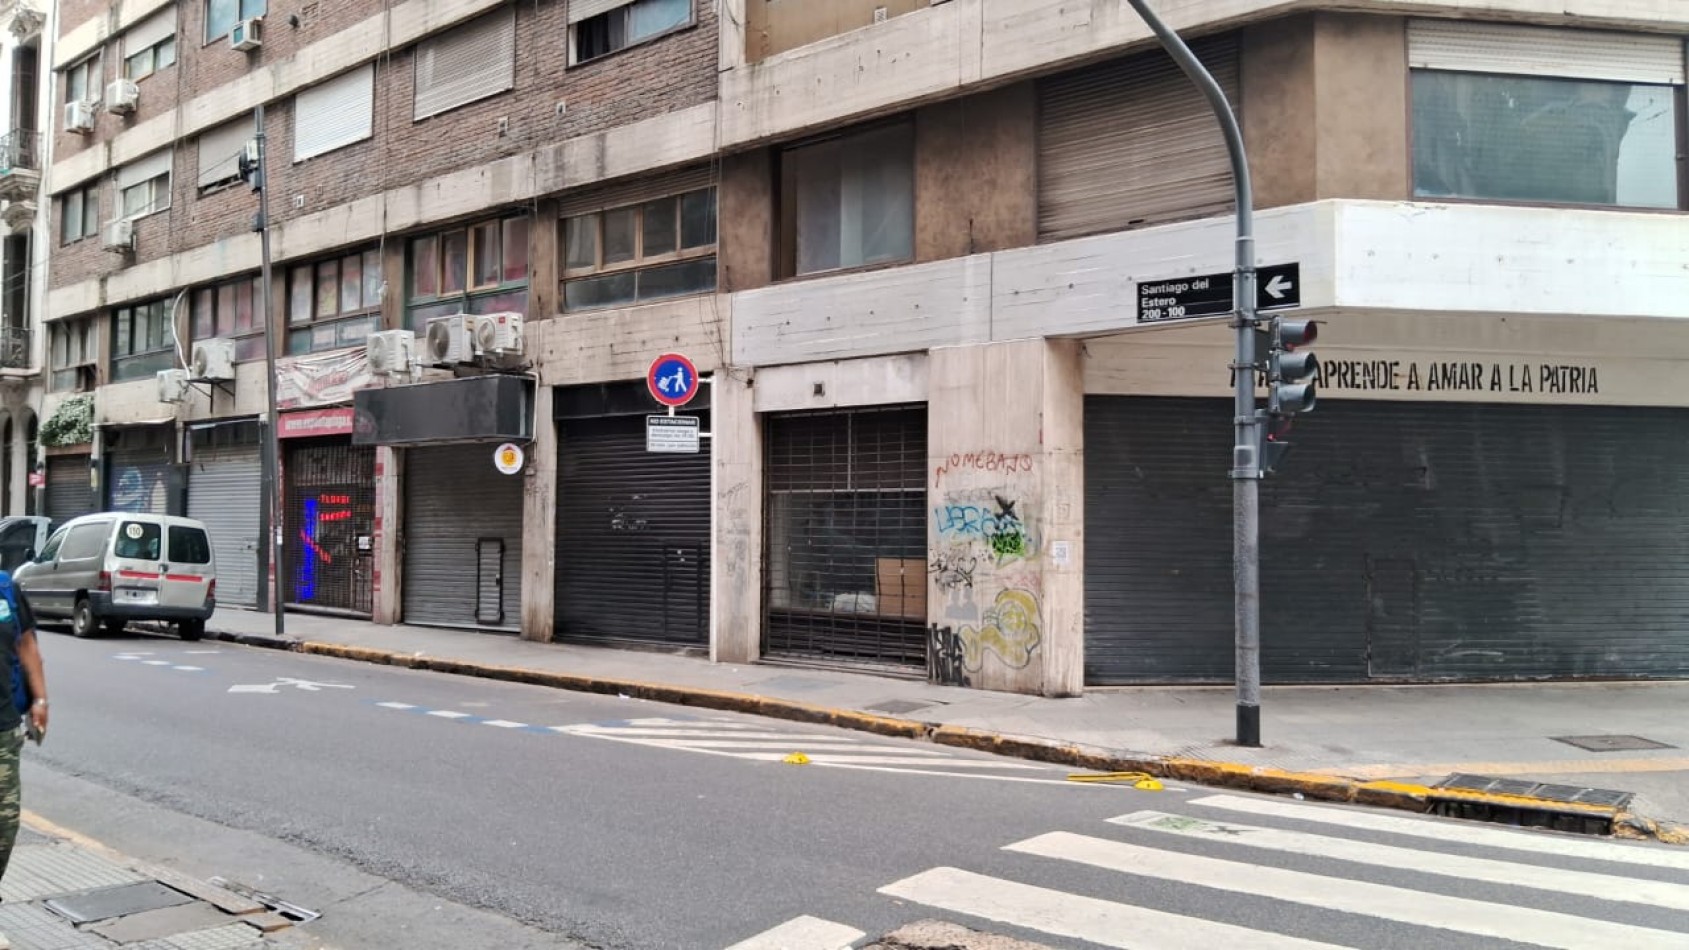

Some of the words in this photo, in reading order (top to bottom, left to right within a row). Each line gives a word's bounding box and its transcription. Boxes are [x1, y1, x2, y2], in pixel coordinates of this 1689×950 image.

[1141, 283, 1189, 295] Santiago
[1193, 277, 1209, 290] del
[1142, 297, 1176, 308] Estero
[1407, 362, 1421, 391] A
[1427, 361, 1483, 391] AMAR
[1490, 363, 1502, 392] A
[1509, 364, 1533, 393] LA
[1539, 364, 1599, 393] PATRIA
